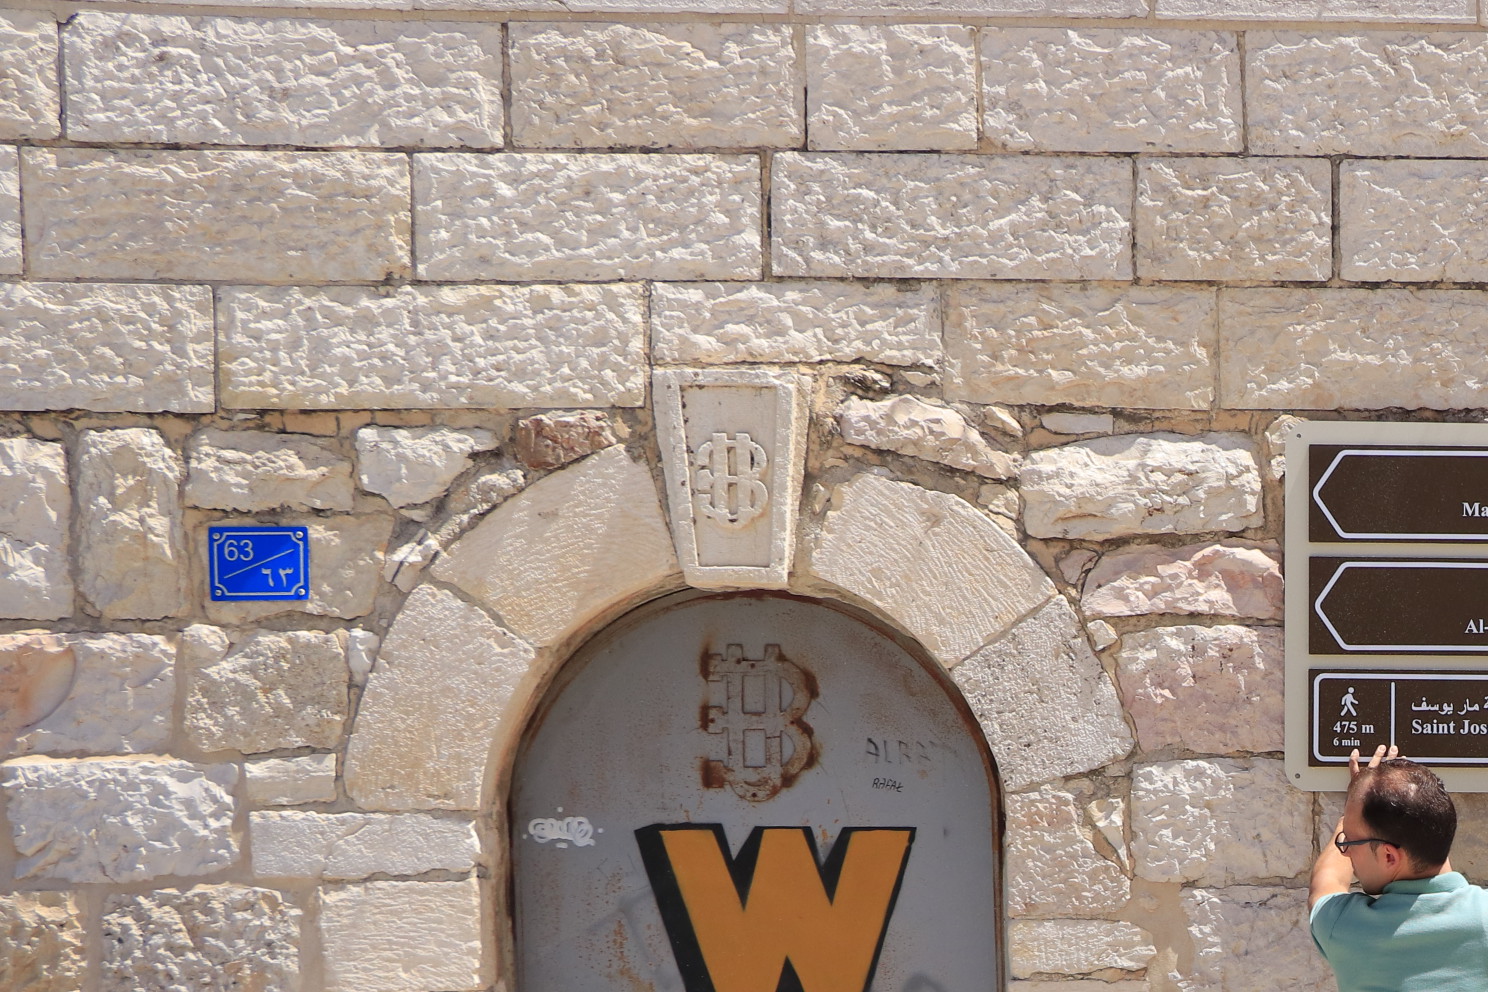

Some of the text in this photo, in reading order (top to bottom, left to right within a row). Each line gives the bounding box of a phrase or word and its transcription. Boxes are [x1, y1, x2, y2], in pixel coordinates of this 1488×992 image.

[223, 539, 255, 562] 63
[1411, 697, 1454, 715] يوسف
[1457, 698, 1480, 716] مار
[1333, 720, 1375, 734] 475 m
[1411, 718, 1456, 735] Saint
[1333, 736, 1361, 747] 6 min
